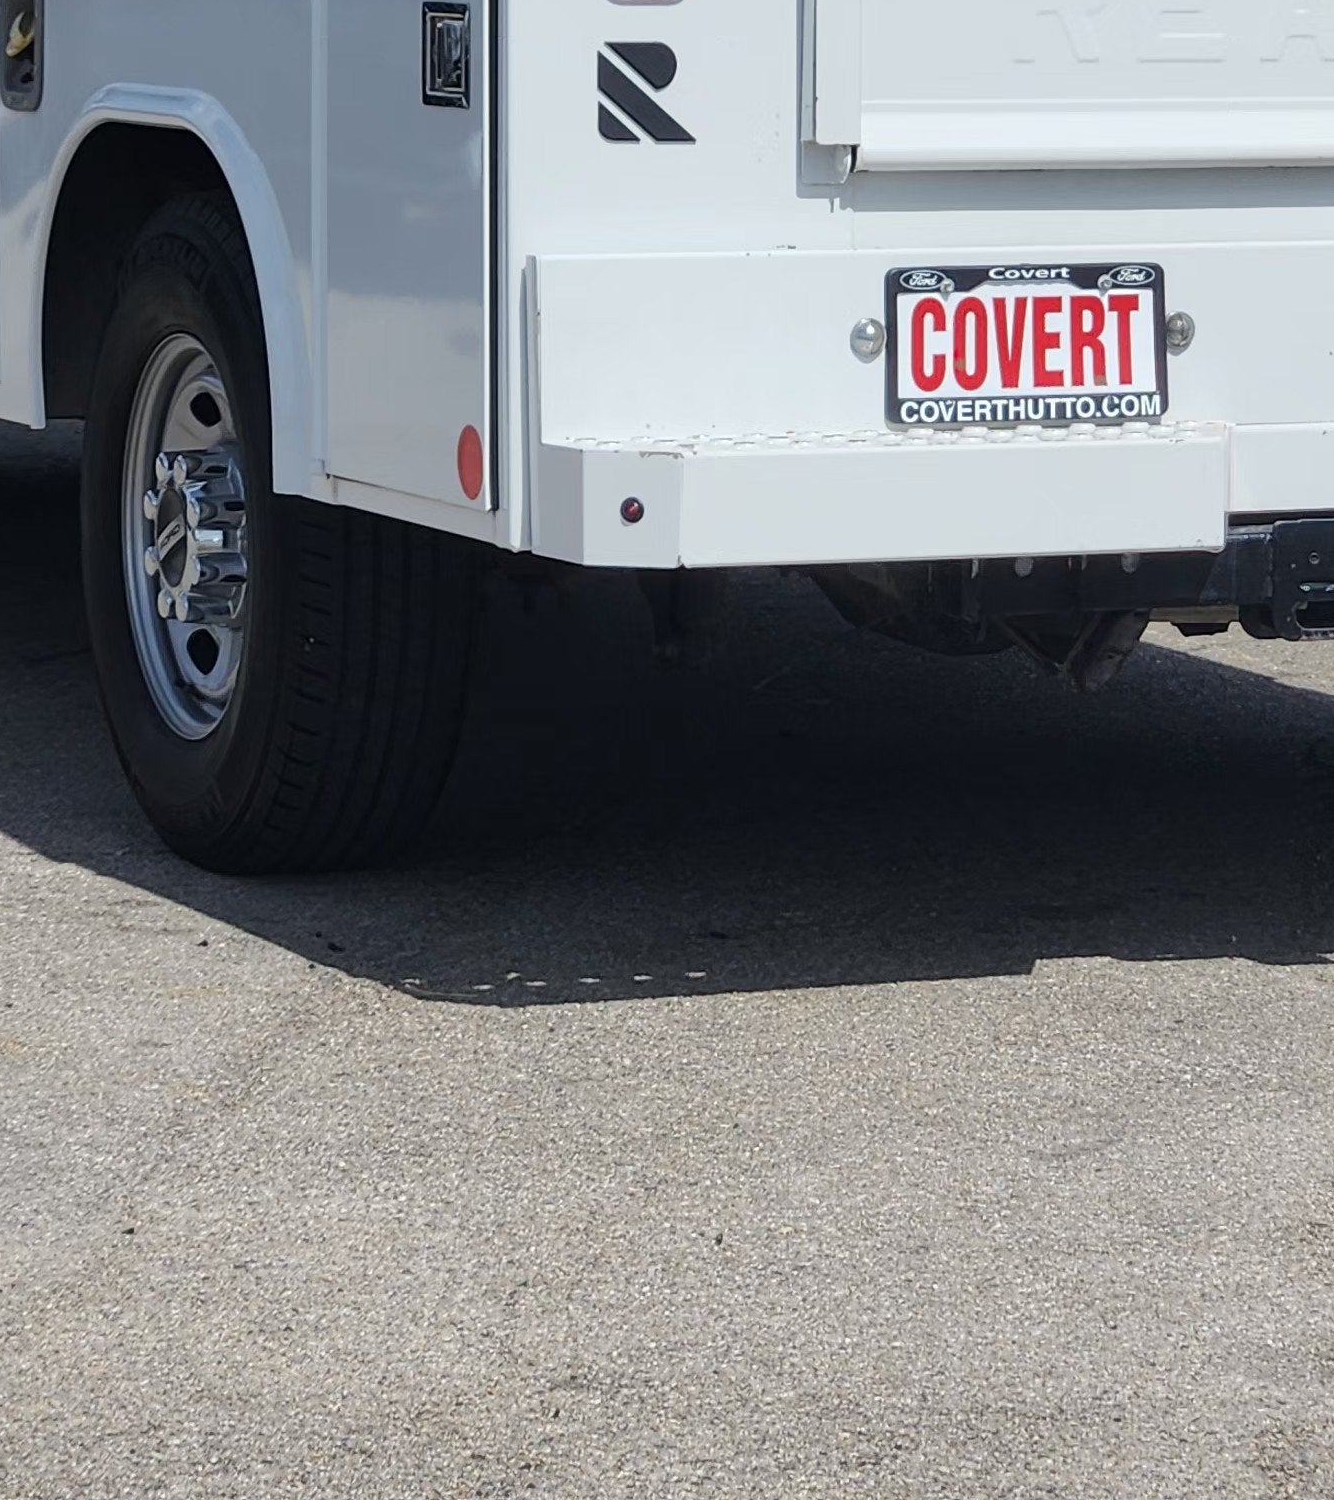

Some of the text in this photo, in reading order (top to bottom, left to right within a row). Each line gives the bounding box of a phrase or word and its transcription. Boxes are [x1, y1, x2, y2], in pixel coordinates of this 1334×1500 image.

[988, 266, 1071, 280] Covert
[910, 294, 1140, 392] COVERT
[899, 394, 1161, 424] COVERTHUTTO.COM
